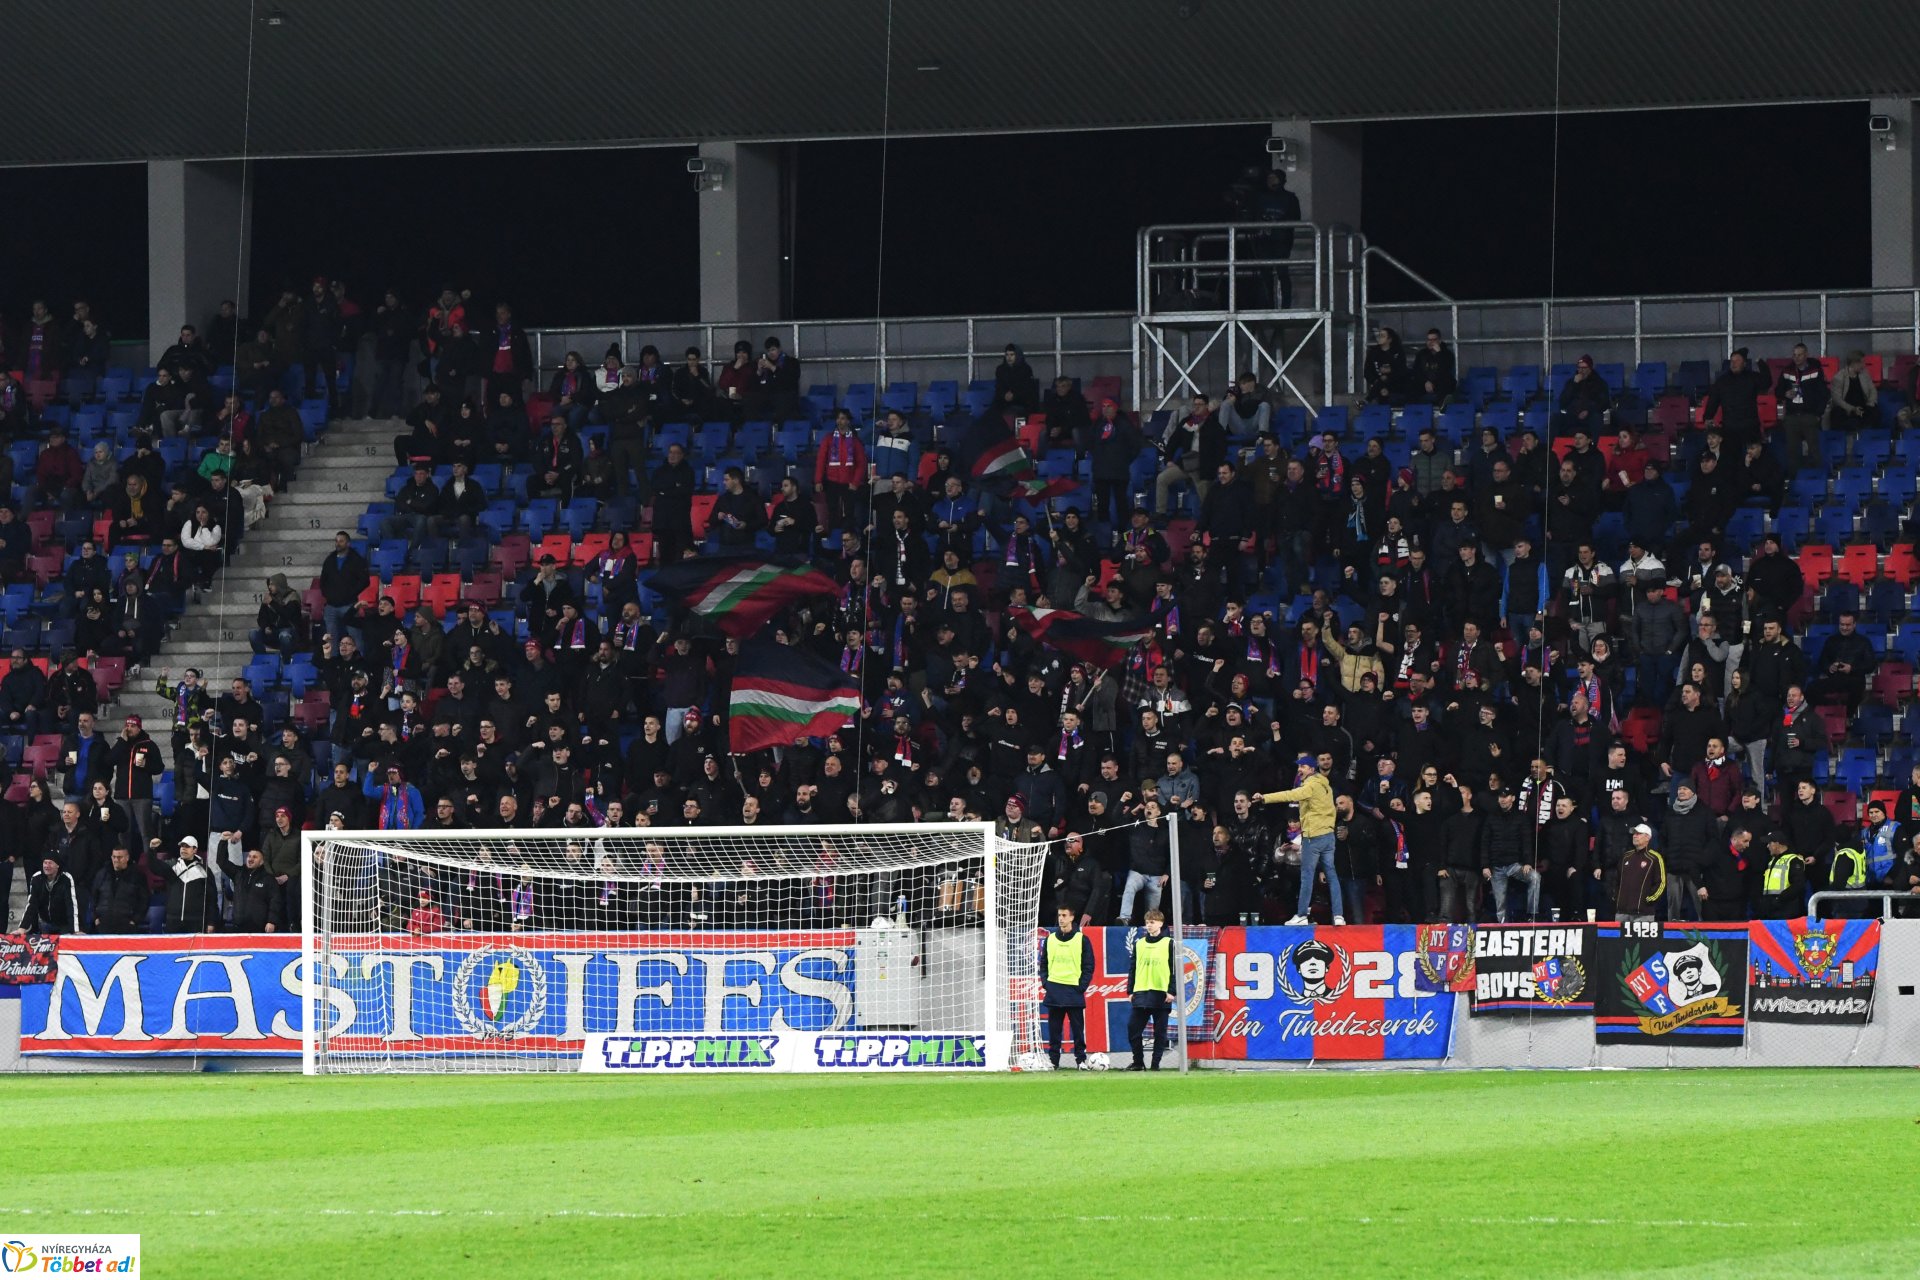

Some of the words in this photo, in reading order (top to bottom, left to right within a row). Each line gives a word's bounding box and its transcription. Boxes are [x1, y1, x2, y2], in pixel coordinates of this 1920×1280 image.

[337, 483, 348, 492] 14
[310, 519, 321, 529] 13
[282, 556, 293, 566] 12
[223, 631, 234, 640] 10
[1623, 921, 1659, 938] 1928
[1475, 928, 1584, 958] EASTERN
[1476, 971, 1536, 1000] BOYS
[1213, 1006, 1265, 1043] Vén
[1278, 1008, 1439, 1042] Tinédzserek
